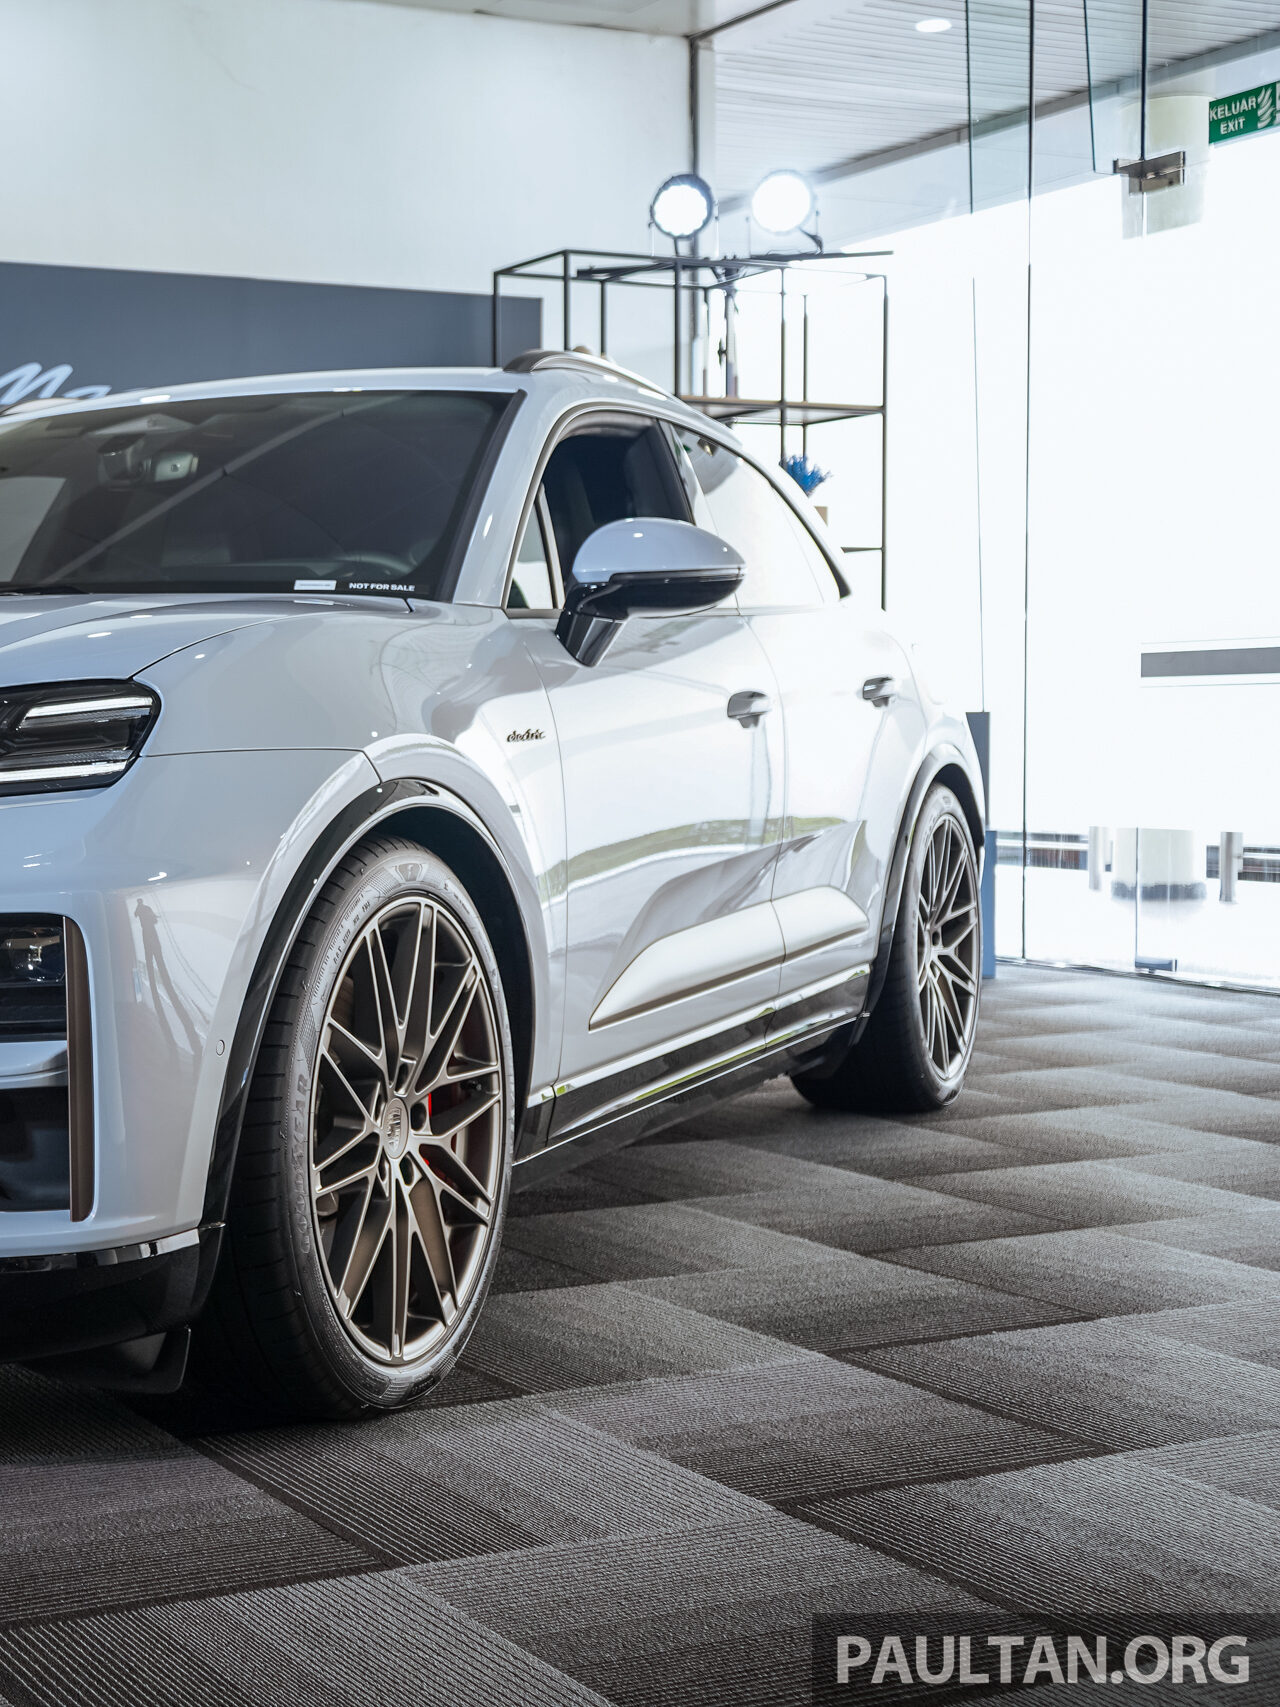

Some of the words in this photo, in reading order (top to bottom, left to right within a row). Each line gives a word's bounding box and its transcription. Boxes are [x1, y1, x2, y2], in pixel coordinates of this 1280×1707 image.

[1209, 97, 1256, 120] KELUAR
[1221, 117, 1245, 134] EXIT
[349, 582, 369, 590] NOT
